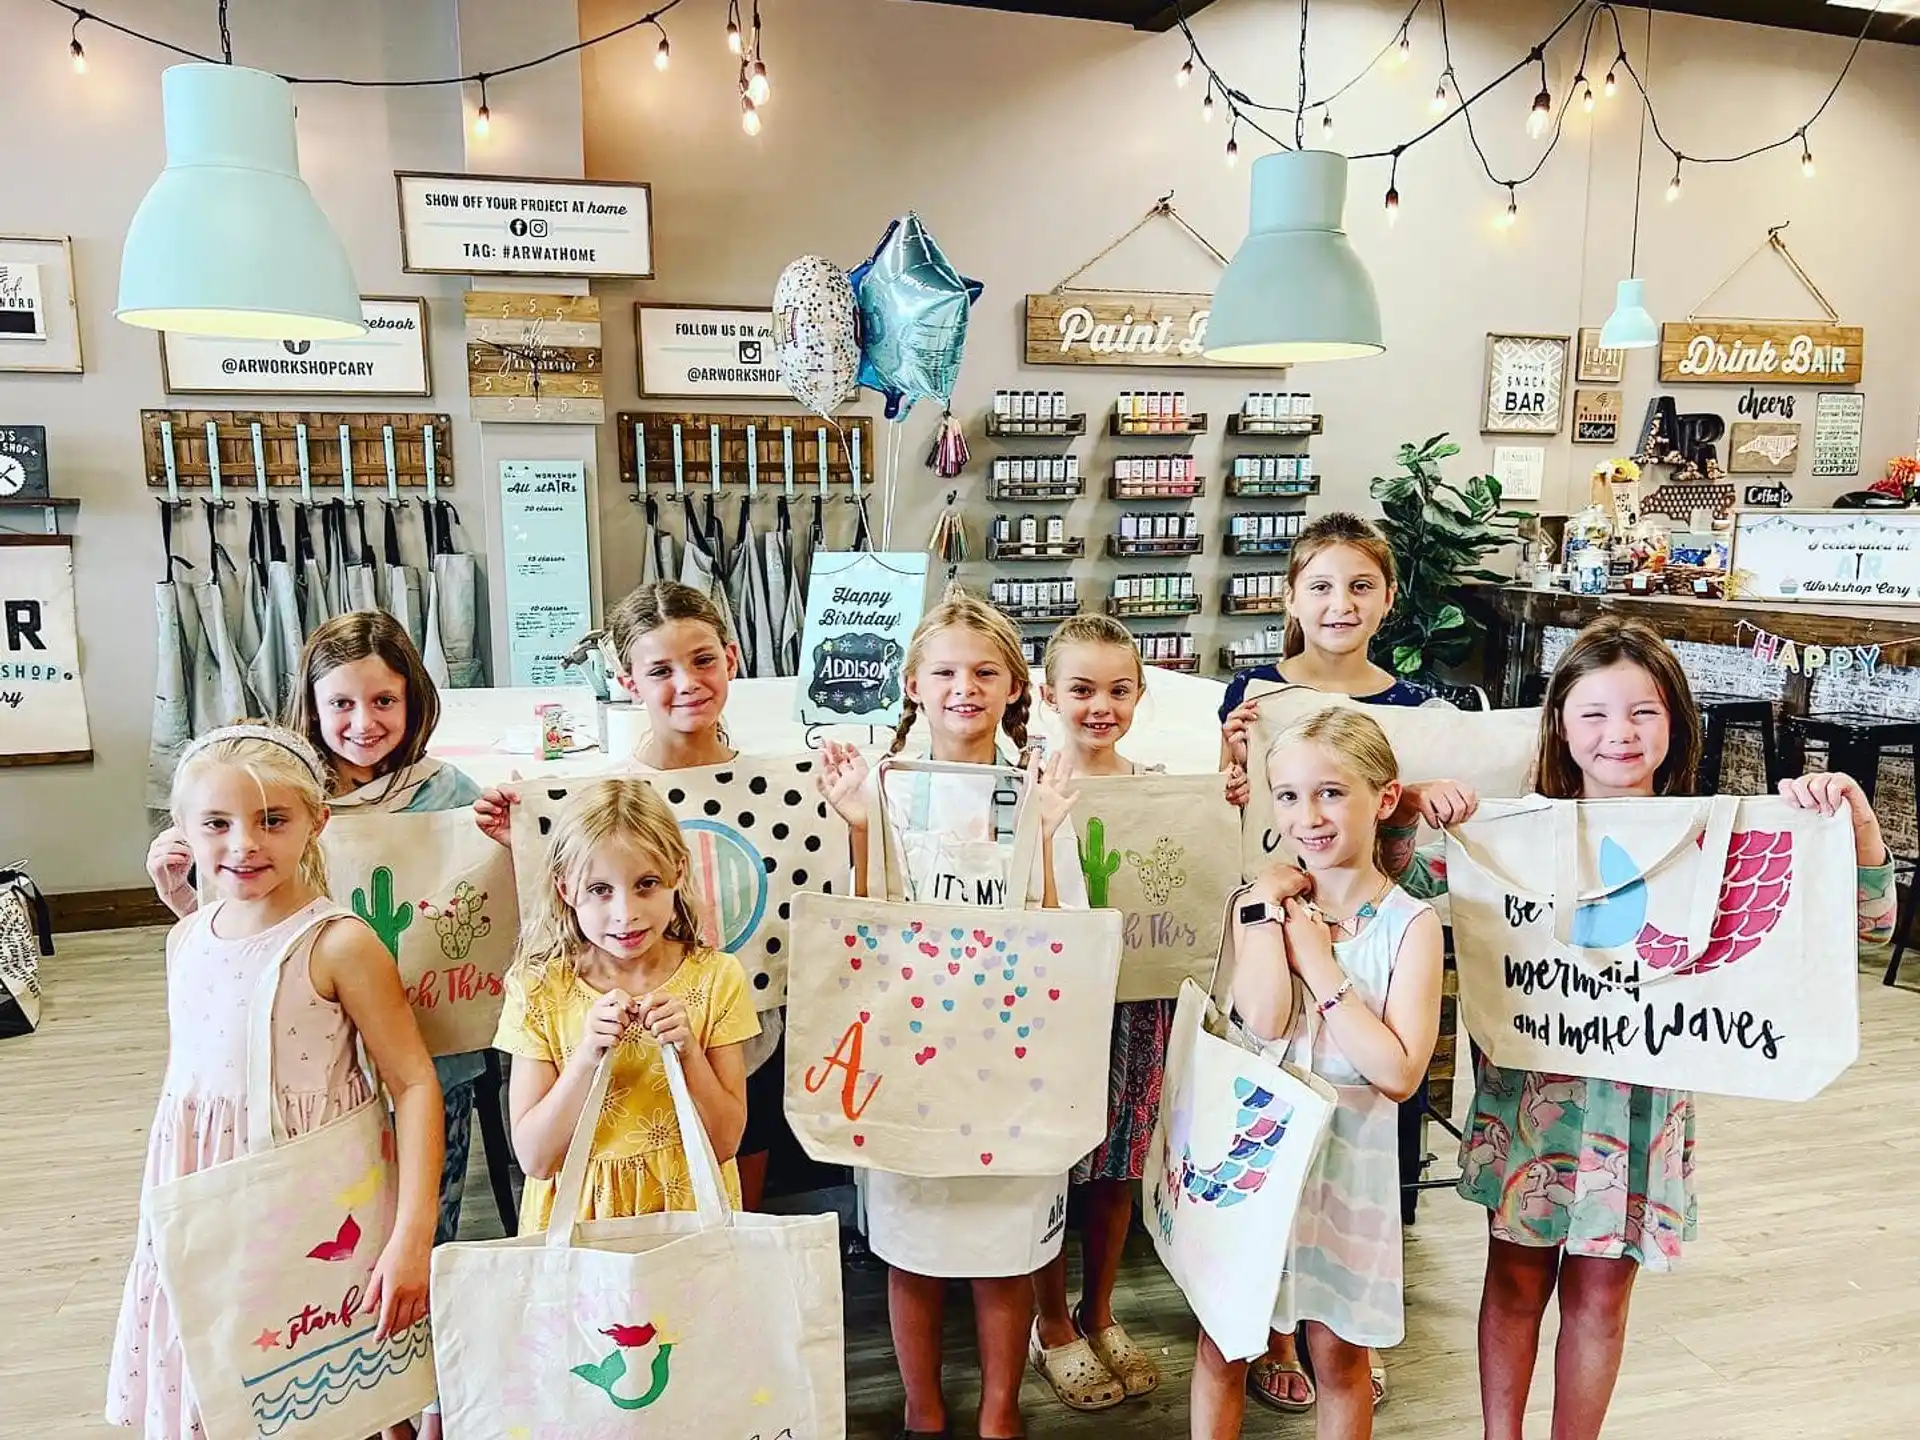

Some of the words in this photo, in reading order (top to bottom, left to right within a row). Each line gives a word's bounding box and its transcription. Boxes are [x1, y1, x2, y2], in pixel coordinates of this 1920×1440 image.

[425, 193, 459, 207] SHOW
[463, 195, 483, 209] OFF
[485, 196, 518, 210] YOUR
[520, 198, 568, 213] PROJECT
[572, 200, 586, 213] AT
[587, 201, 628, 216] home
[463, 243, 496, 258] TAG:
[502, 245, 597, 262] #ARWATHOME
[503, 304, 510, 319] 5
[529, 299, 536, 313] 5
[556, 307, 563, 322] 5
[363, 316, 416, 330] ebook
[676, 323, 718, 337] FOLLOW
[722, 324, 736, 337] US
[740, 325, 754, 337] ON
[1058, 306, 1174, 354] Paint
[474, 350, 482, 365] 5
[588, 353, 596, 369] 5
[1678, 335, 1779, 375] Drink
[222, 358, 374, 376] @ARWORKSHOPCARY
[687, 367, 783, 383] @ARWORKSHOP
[485, 376, 492, 392] 5
[581, 379, 589, 394] 5
[1505, 391, 1545, 411] BAR
[1737, 387, 1796, 420] cheers
[507, 482, 531, 494] All
[832, 587, 892, 608] Happy
[1803, 580, 1872, 596] Workshop
[1876, 582, 1911, 598] Cary
[5, 600, 47, 651] R
[818, 608, 901, 632] Birthday!
[1752, 629, 1881, 678] HAPPY
[1, 664, 57, 681] SHOP
[820, 655, 891, 680] ADDISON
[1504, 894, 1543, 927] Be
[1146, 912, 1198, 948] This
[443, 963, 503, 1004] This
[1514, 1012, 1550, 1046] and
[1559, 1012, 1638, 1055] make
[805, 1021, 882, 1121] A
